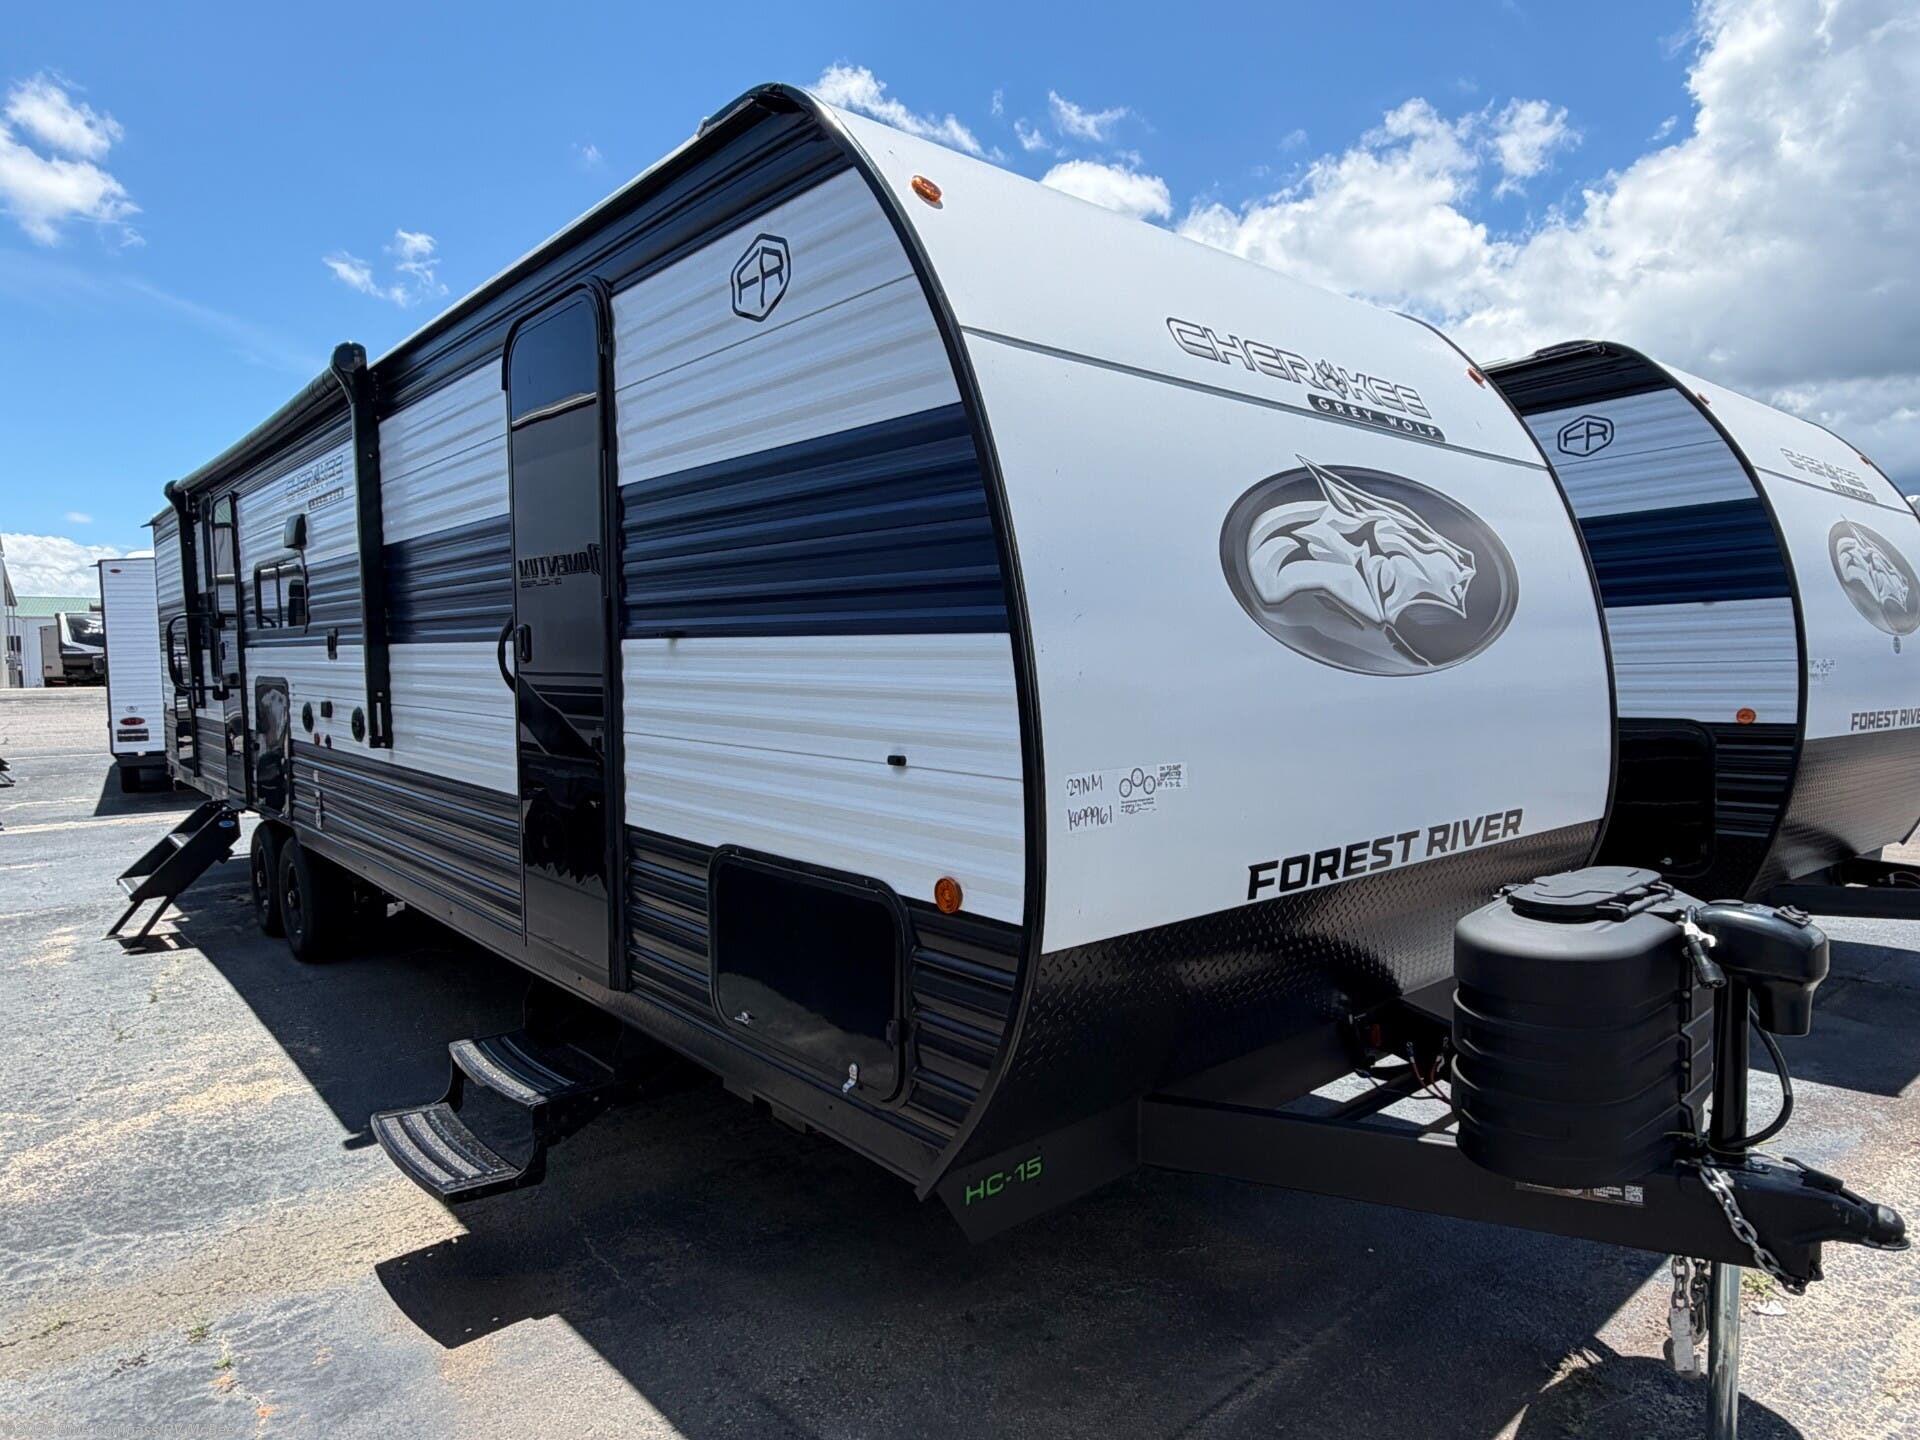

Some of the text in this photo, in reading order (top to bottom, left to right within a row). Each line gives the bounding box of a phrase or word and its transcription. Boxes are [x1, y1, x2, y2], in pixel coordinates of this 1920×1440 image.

[1318, 398, 1437, 437] GREY WOLF
[1851, 708, 1920, 732] FOREST RIVE
[1066, 773, 1103, 796] 29NM
[1247, 808, 1523, 900] FOREST RIVER
